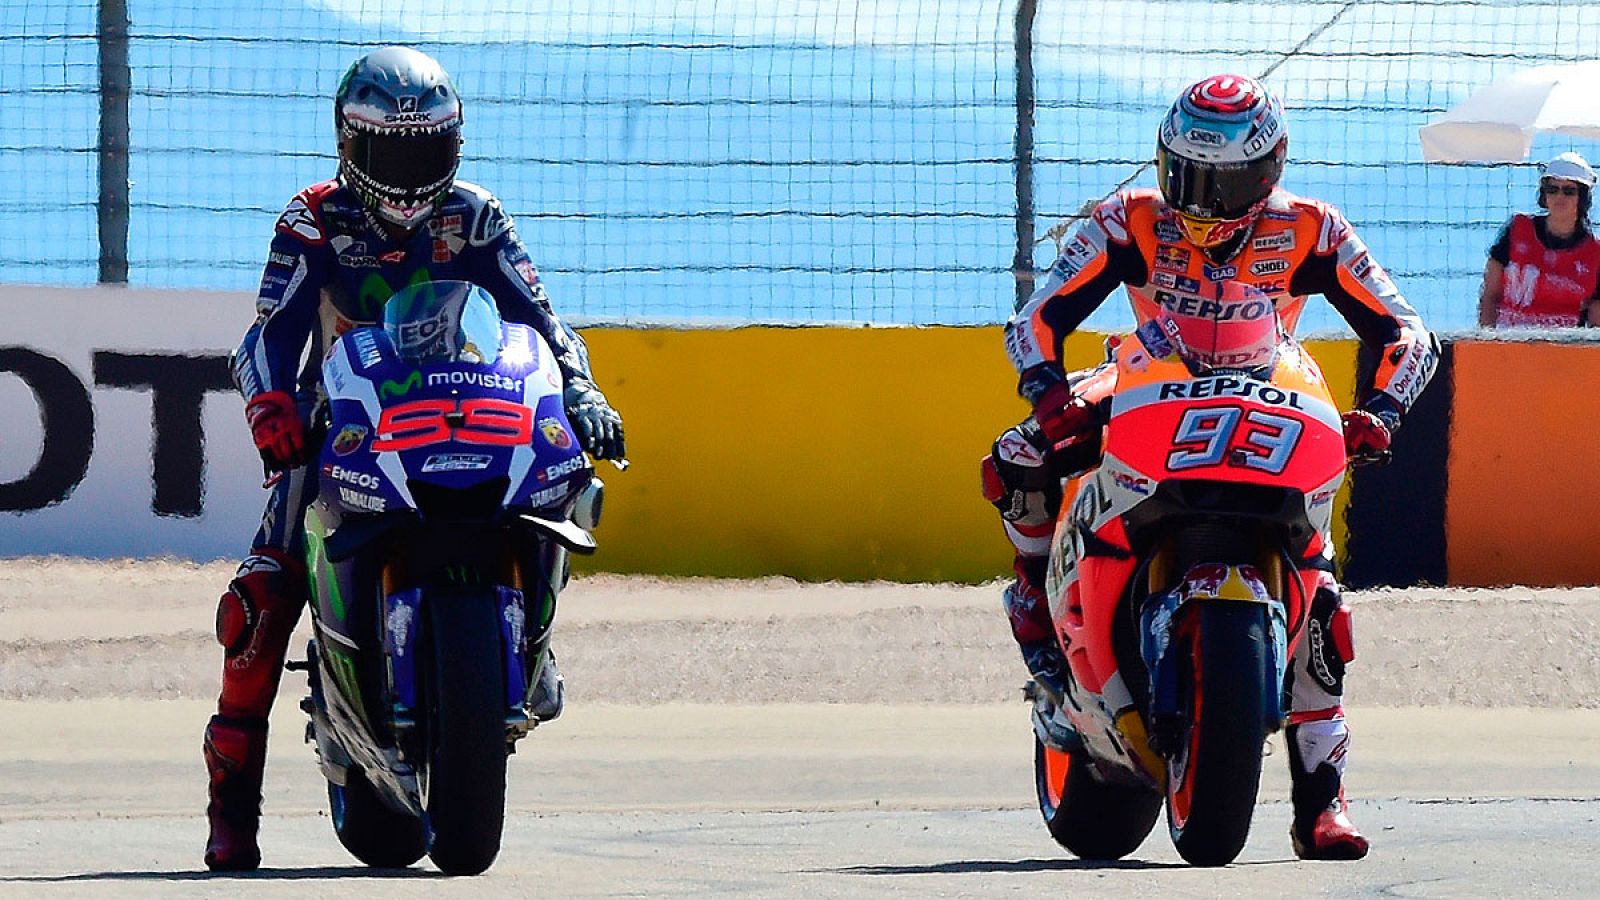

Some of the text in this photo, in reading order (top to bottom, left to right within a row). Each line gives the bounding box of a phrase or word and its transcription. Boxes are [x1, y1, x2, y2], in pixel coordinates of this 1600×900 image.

[384, 112, 432, 123] SHARK
[1243, 117, 1279, 158] LOTUS
[1254, 261, 1285, 273] SHOEI
[428, 371, 522, 393] movistar
[1159, 377, 1304, 410] REPSOL
[369, 398, 533, 453] 99
[1164, 403, 1305, 476] 93
[332, 466, 380, 489] ENEOS
[547, 456, 584, 480] ENEOS
